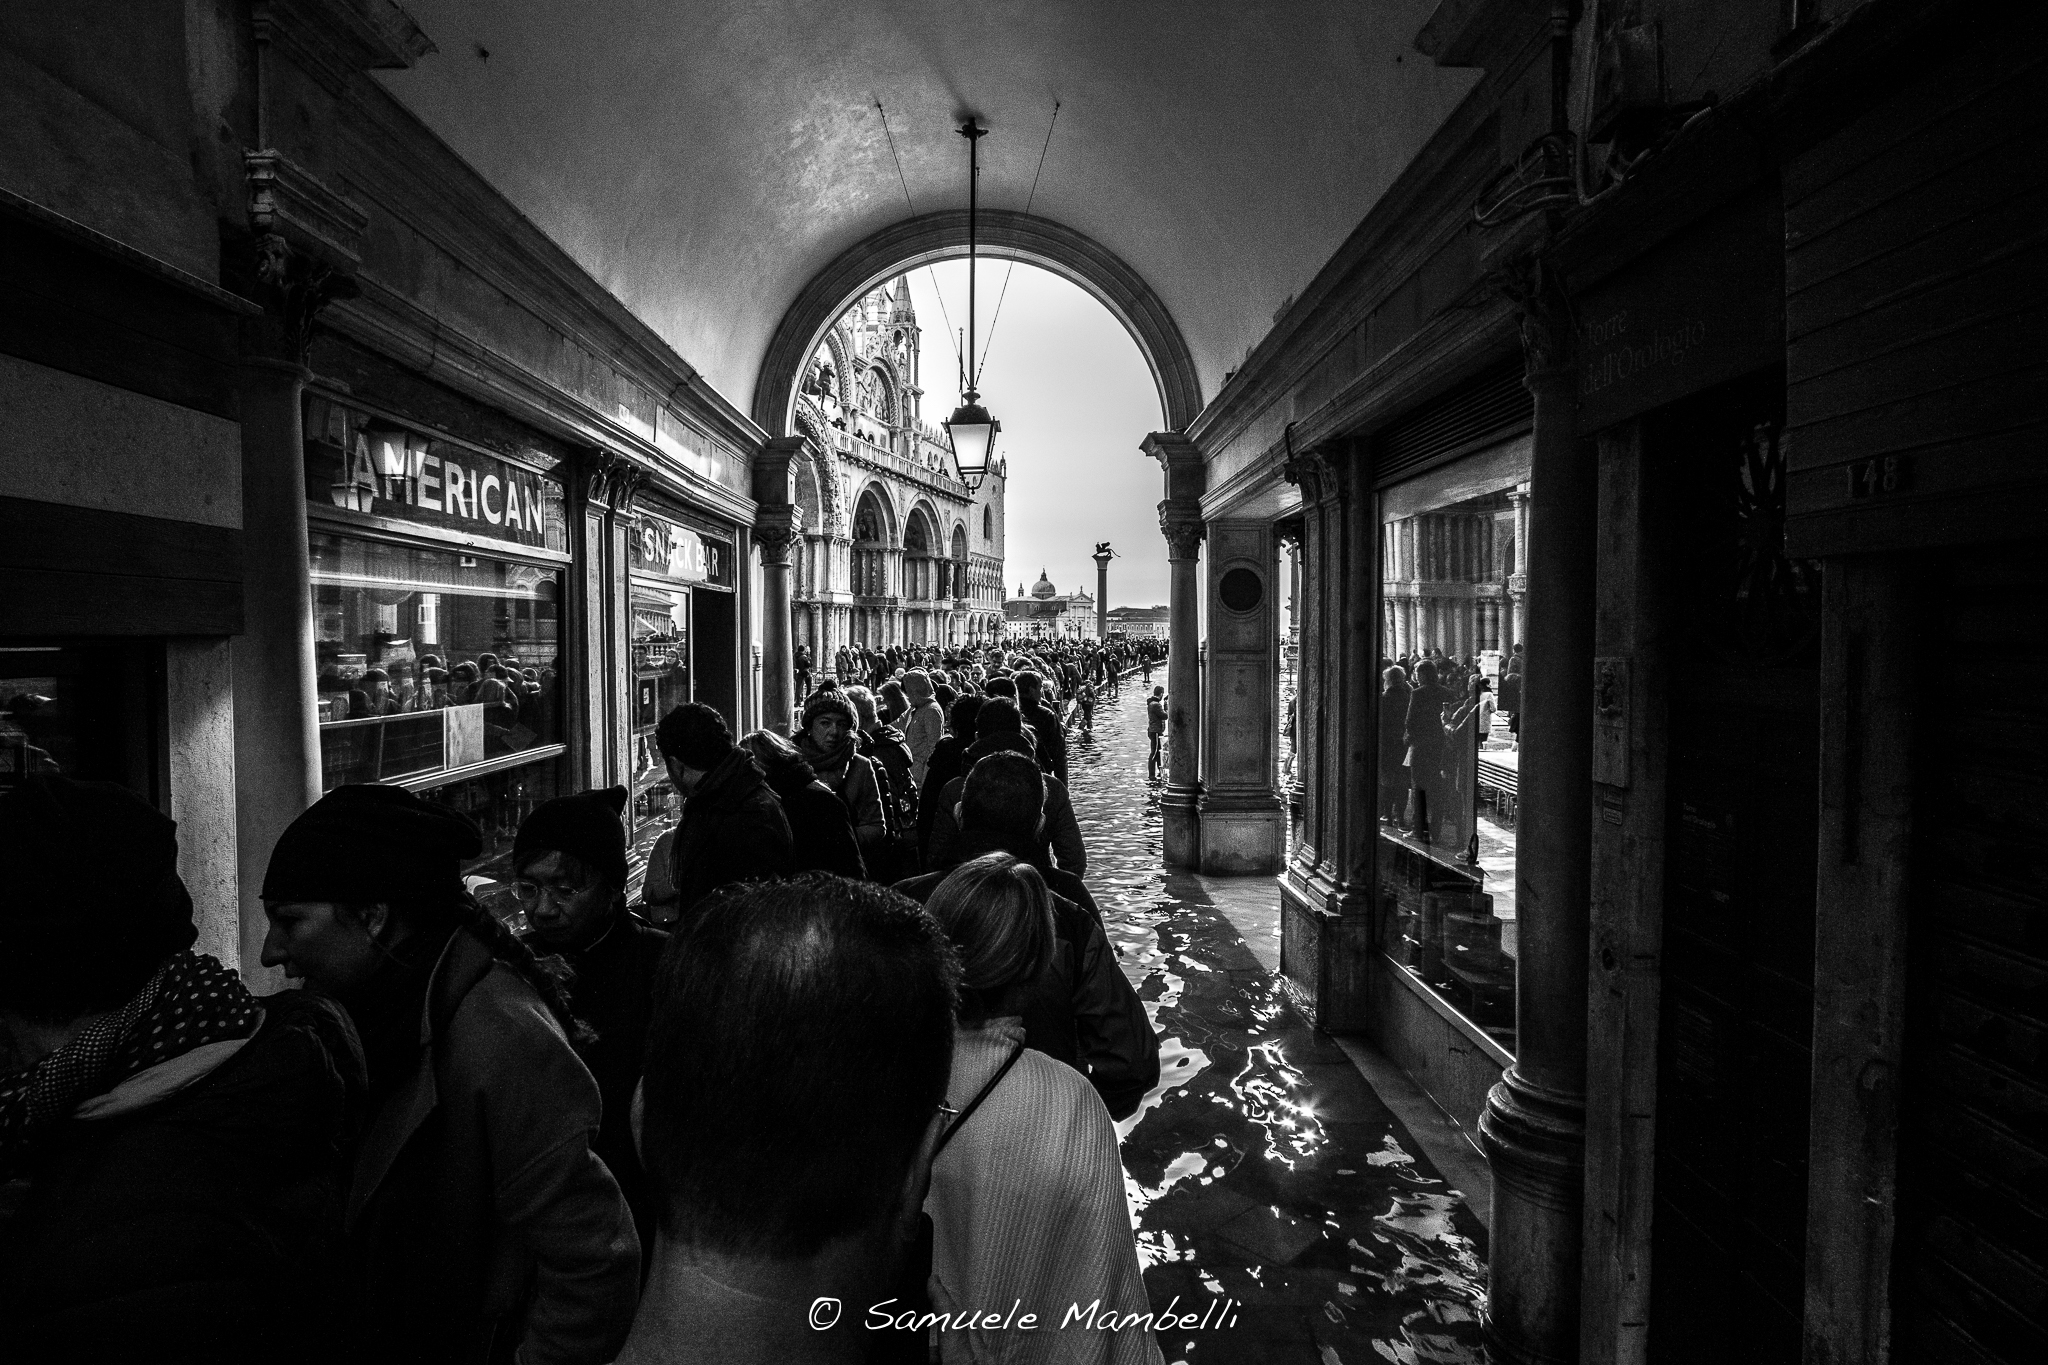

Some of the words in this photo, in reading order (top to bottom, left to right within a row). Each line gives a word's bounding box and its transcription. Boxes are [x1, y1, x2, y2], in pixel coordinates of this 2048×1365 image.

[1585, 309, 1628, 348] Torre
[1584, 317, 1705, 395] dell'Orologio
[349, 431, 543, 535] AMERICAN
[1846, 456, 1899, 498] 148
[644, 528, 693, 571] SNACK
[696, 542, 718, 576] BAR
